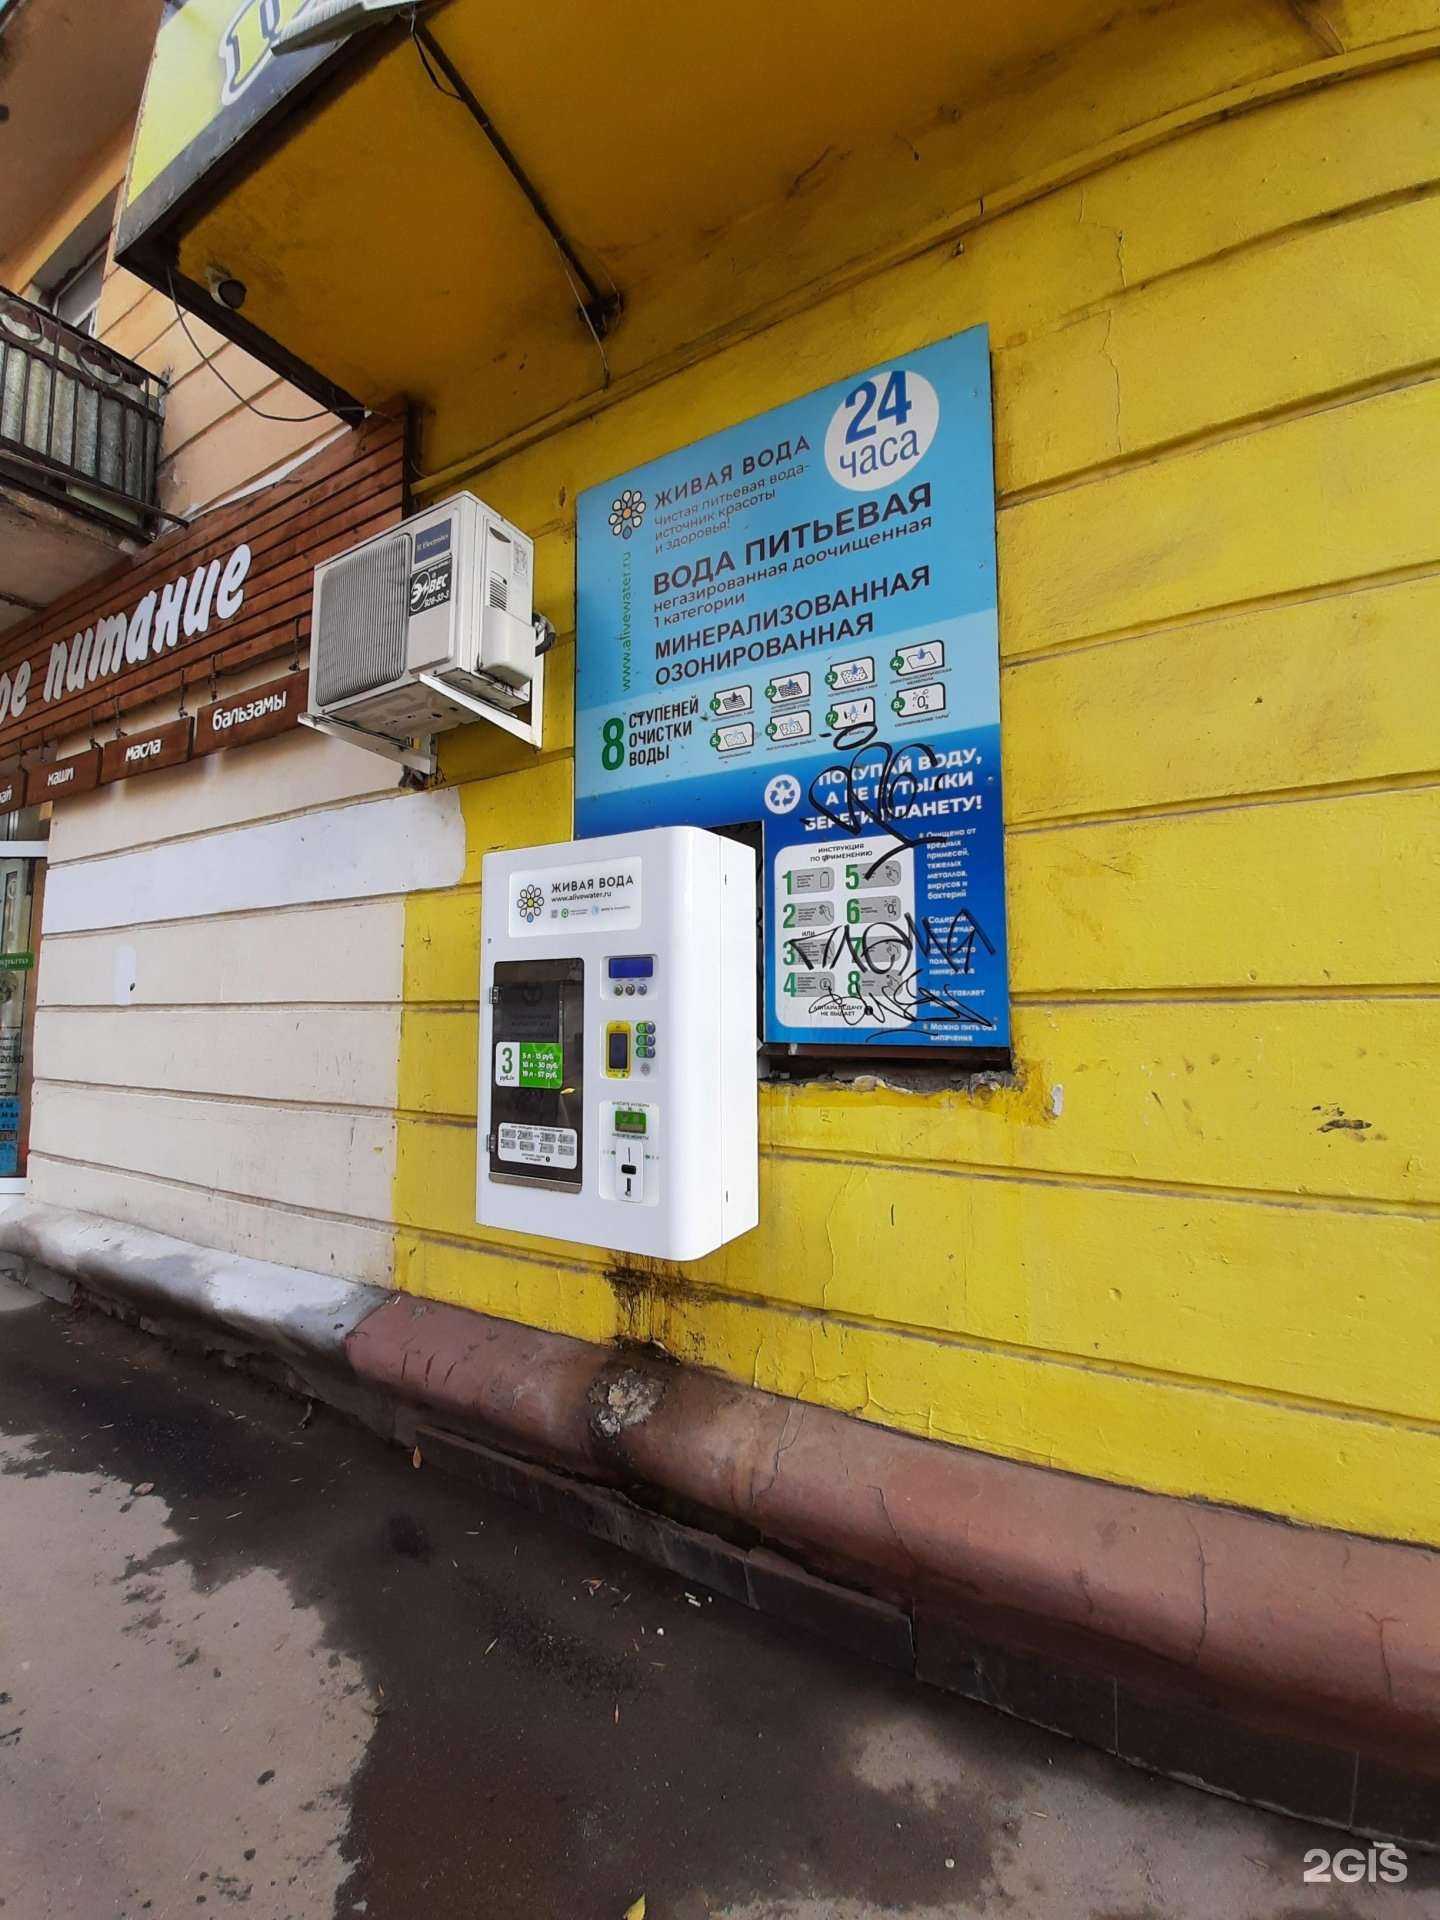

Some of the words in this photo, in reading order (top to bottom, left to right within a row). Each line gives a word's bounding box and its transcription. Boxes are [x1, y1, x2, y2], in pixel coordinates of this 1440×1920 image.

[845, 370, 912, 445] 24
[840, 429, 920, 478] часа
[655, 464, 732, 510] ЖИВАЯ
[742, 435, 810, 475] ВОДА
[655, 504, 698, 526] Чистая
[702, 478, 765, 511] питьевая
[655, 514, 715, 541] источник
[718, 489, 776, 519] красоты
[653, 551, 736, 596] ВОДА
[744, 482, 931, 566] ПИТЬЕВАЯ
[666, 518, 730, 550] здоровья!
[654, 561, 788, 613] негазированная
[792, 516, 932, 572] доочищенная
[43, 544, 251, 702] питание
[621, 551, 632, 692] www.alivewater.ru
[654, 615, 660, 628] 1
[664, 593, 745, 627] категории
[655, 565, 931, 660] МИНЕРАЛИЗОВАННАЯ
[655, 612, 874, 686] ОЗОНИРОВАННАЯ
[212, 691, 287, 732] бальзамы
[629, 695, 698, 729] СТУПЕНЕЙ
[602, 717, 625, 771] 8
[629, 720, 692, 748] ОЧИСТКИ
[125, 738, 162, 762] масла
[629, 745, 670, 767] ВОДЫ
[918, 748, 982, 771] ВОДУ,
[48, 767, 74, 787] каши
[826, 792, 839, 806] А
[818, 843, 865, 854] ИНСТРУКЦИЯ
[821, 850, 872, 862] ПРИМЕНЕНИЮ
[552, 878, 594, 894] ЖИВАЯ
[599, 874, 634, 889] ВОДА
[782, 870, 792, 895] 1
[845, 864, 859, 890] 5
[551, 891, 612, 903] www.alivewater.ru
[783, 904, 796, 928] 2
[847, 898, 859, 924] 6
[783, 941, 795, 965] 3
[783, 972, 797, 997] 4
[848, 971, 860, 998] 8
[502, 1047, 513, 1074] 3
